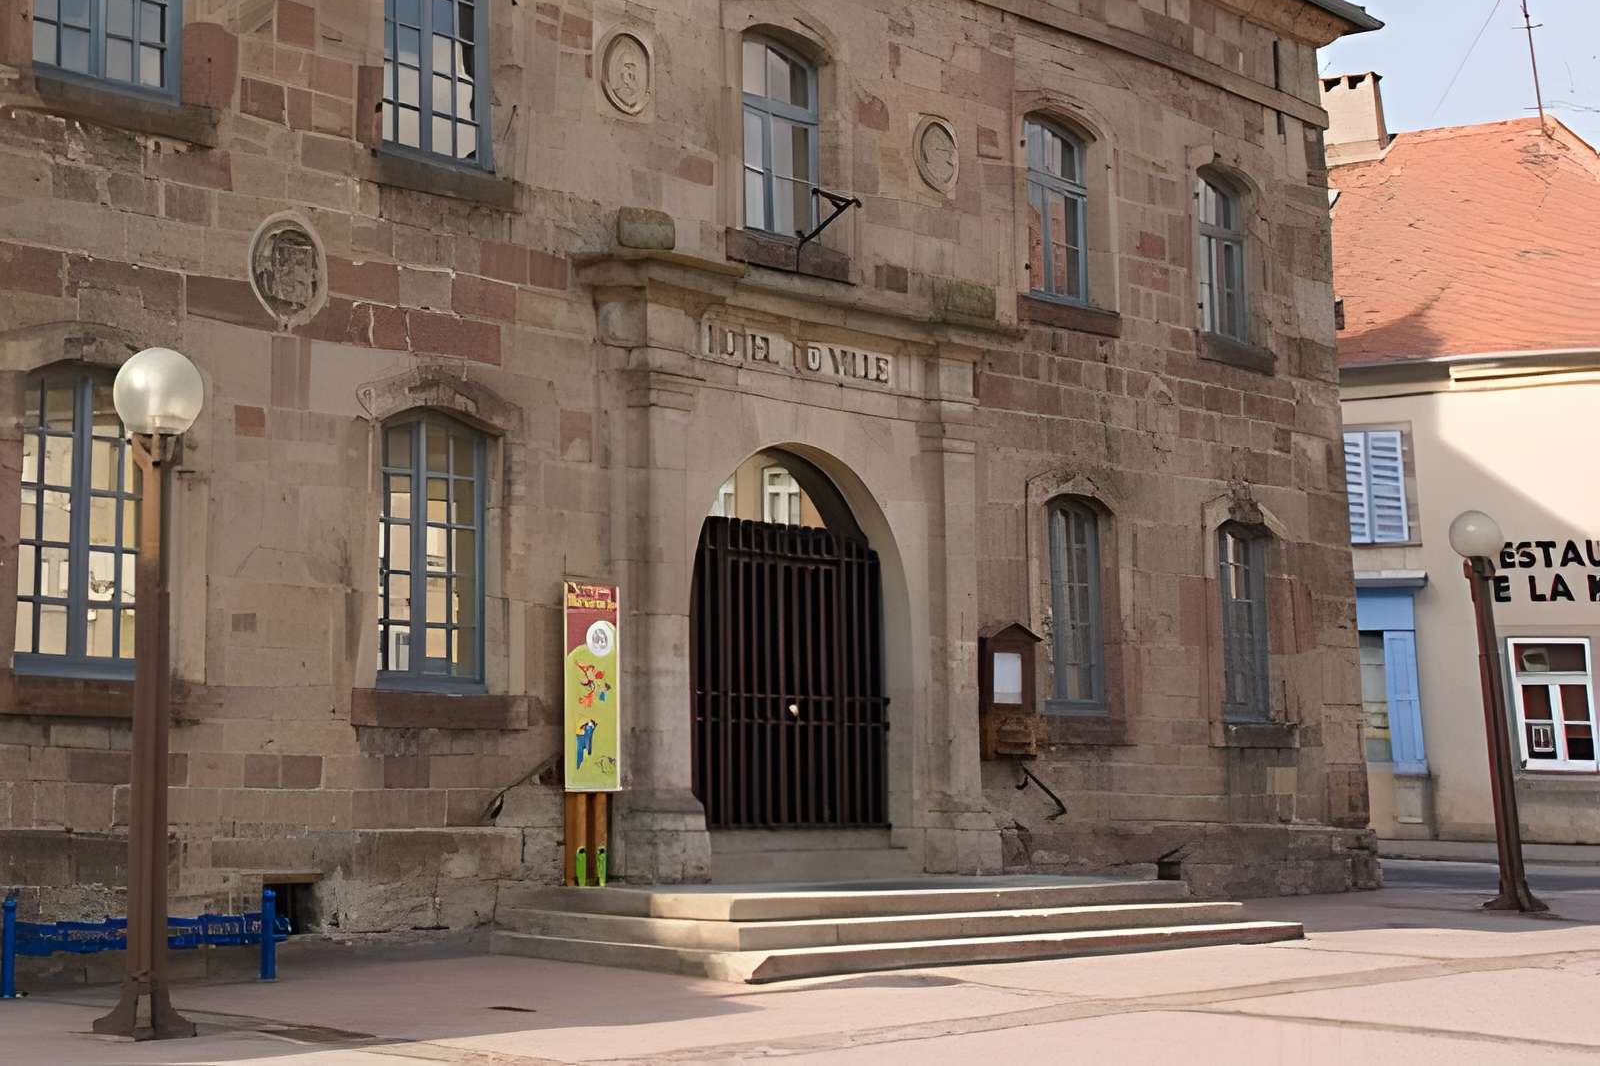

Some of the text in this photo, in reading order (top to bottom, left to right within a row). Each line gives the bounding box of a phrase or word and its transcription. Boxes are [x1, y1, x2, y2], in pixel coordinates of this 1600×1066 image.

[1500, 539, 1600, 569] ESTAU
[1494, 574, 1512, 602] E
[1528, 573, 1576, 602] LA
